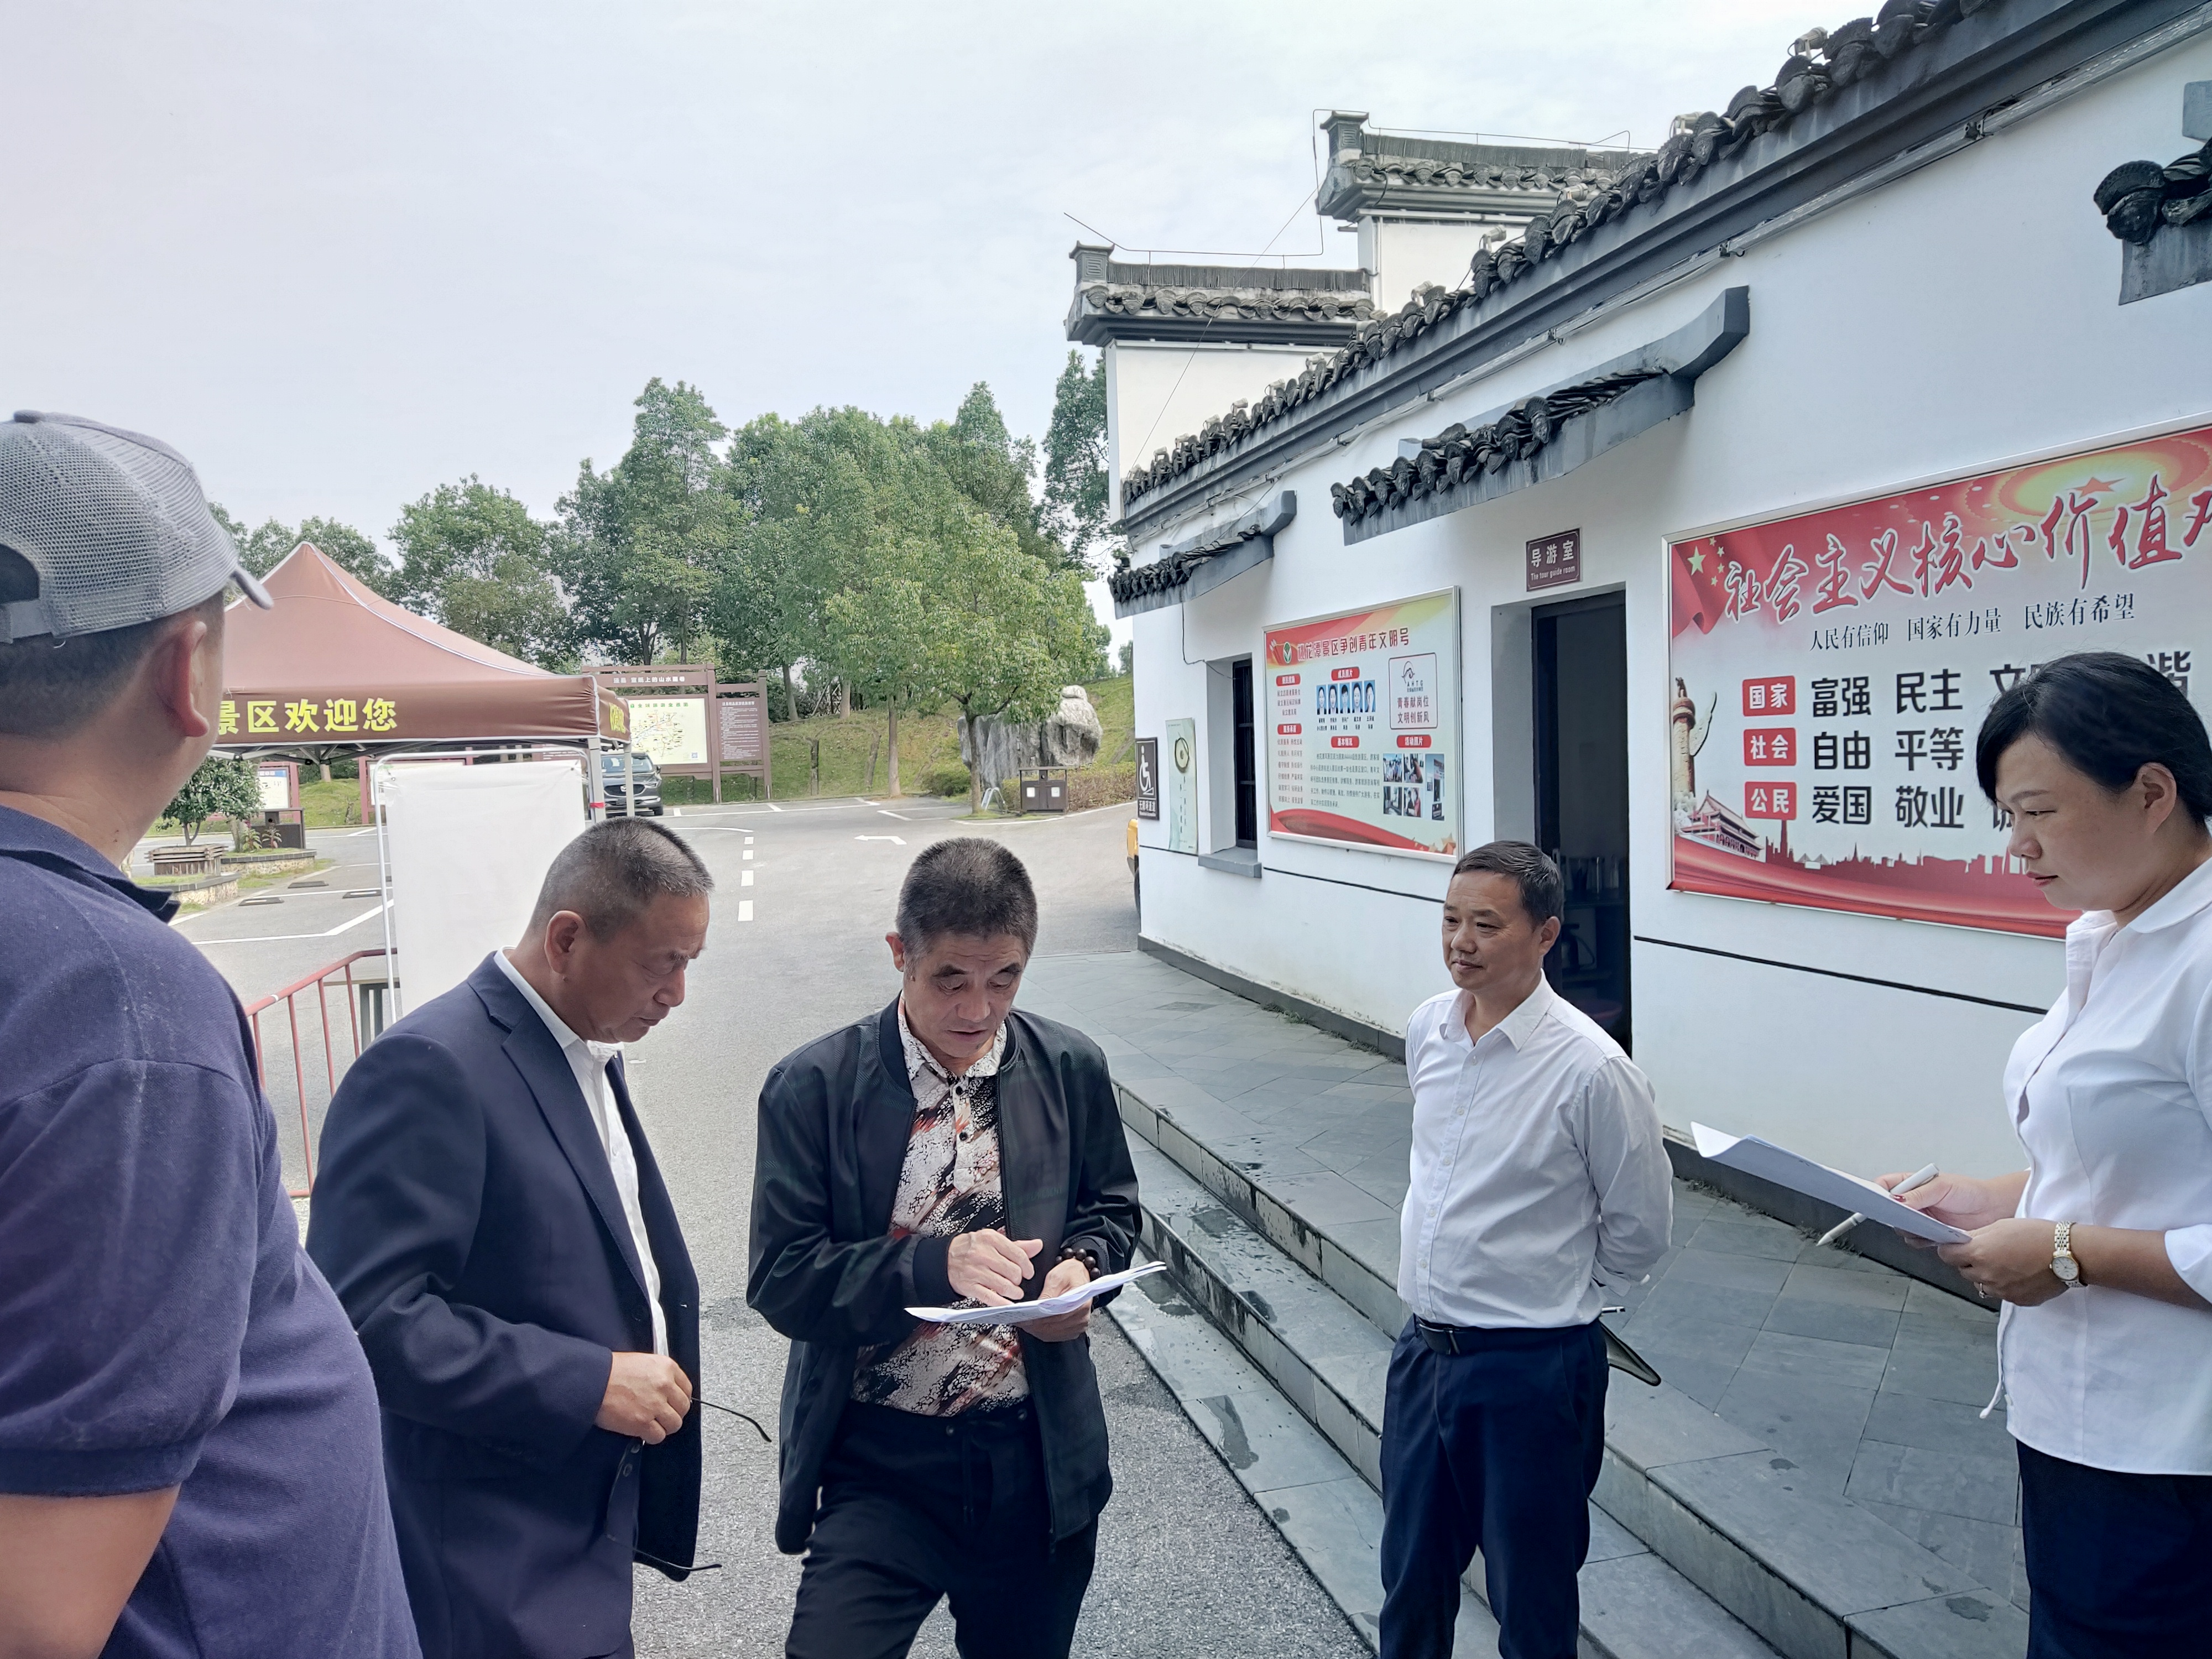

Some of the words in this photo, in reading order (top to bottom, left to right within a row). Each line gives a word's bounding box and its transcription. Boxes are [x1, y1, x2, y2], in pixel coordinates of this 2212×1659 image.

[1531, 540, 1574, 567] 导游室
[1550, 567, 1562, 578] guide
[1809, 622, 1890, 652] 人民有信仰
[1907, 608, 2002, 642] 国家有力量
[2024, 593, 2135, 630] 民族有希望
[1297, 627, 1409, 660] 桃花潭景区争创青年文明号
[1397, 695, 1429, 708] 青春献岗位
[1749, 682, 1789, 710] 国家
[1811, 677, 1872, 718] 富强
[1896, 670, 1963, 713] 民主
[1397, 711, 1430, 723] 文明创新风
[1405, 737, 1423, 746] 活动照片
[1750, 734, 1789, 761] 社会
[1813, 732, 1871, 770] 自由
[1896, 727, 1964, 771] 平等
[1751, 787, 1790, 814] 公民
[1812, 785, 1872, 825] 爱国
[1896, 786, 1964, 829] 敬业
